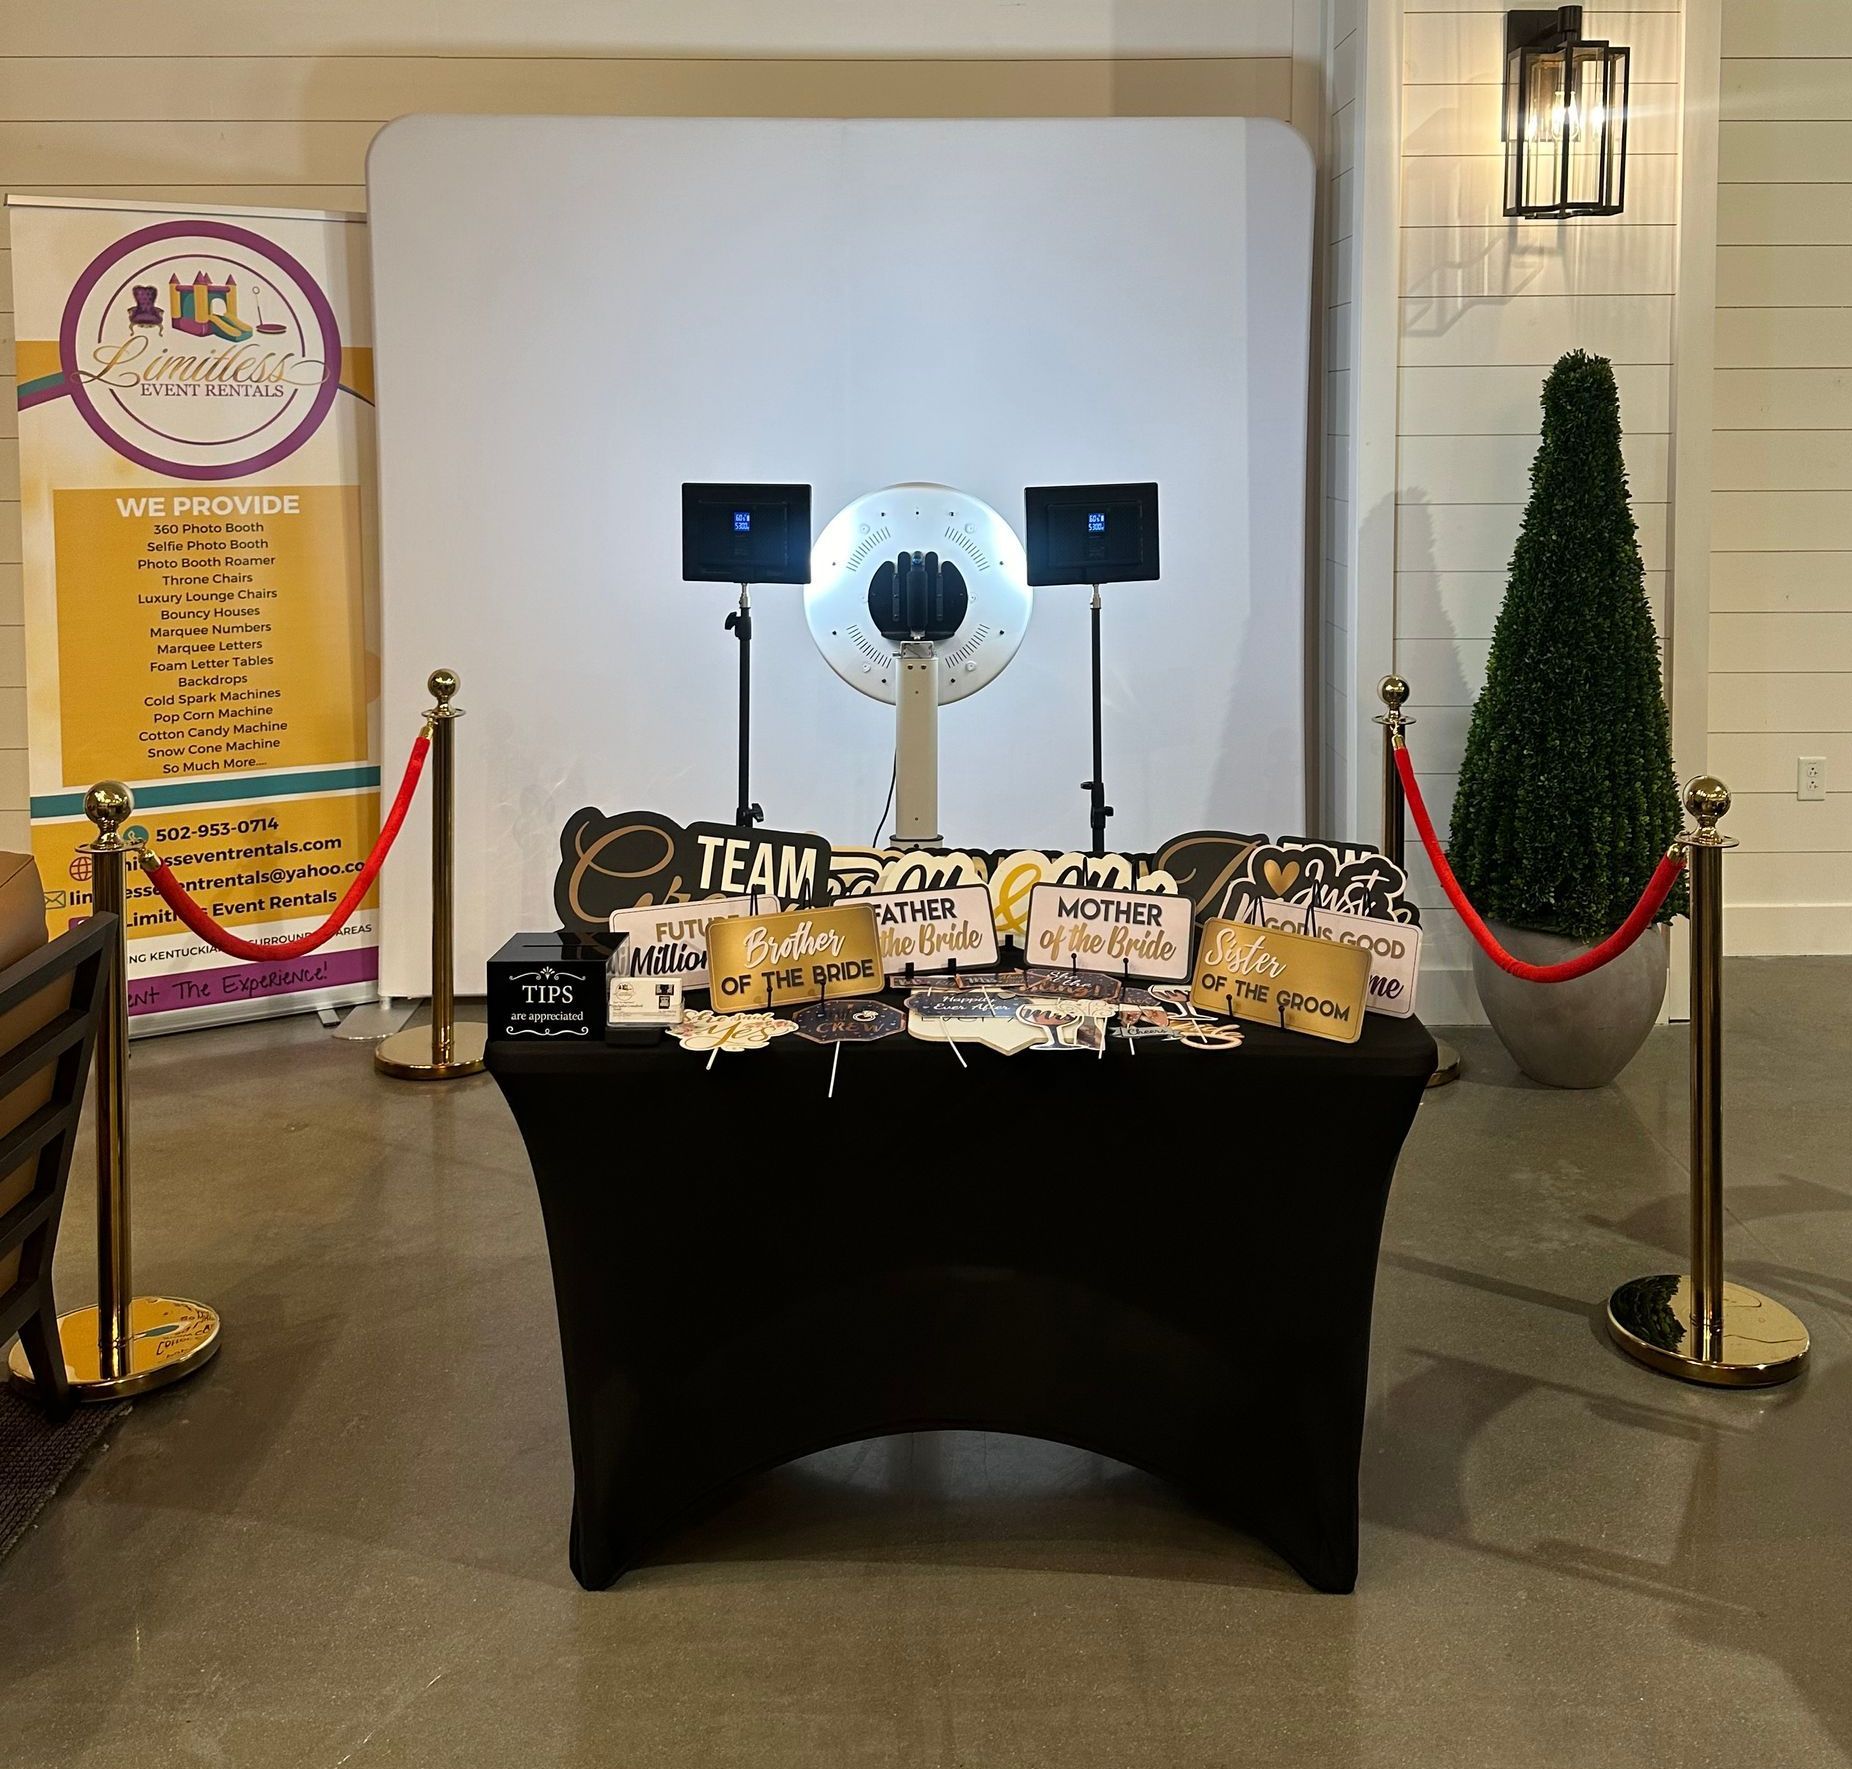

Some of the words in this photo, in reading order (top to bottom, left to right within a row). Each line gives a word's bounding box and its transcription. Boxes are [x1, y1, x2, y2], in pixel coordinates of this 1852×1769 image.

[70, 335, 331, 388] Limitless
[140, 383, 200, 397] EVENT
[206, 384, 284, 398] RENTALS
[116, 497, 165, 518] WE
[173, 495, 300, 516] PROVIDE
[153, 524, 179, 535] 360
[182, 523, 222, 535] Photo
[225, 522, 264, 533] Booth
[147, 541, 183, 552] Selfie
[187, 540, 227, 551] Photo
[230, 538, 269, 550] Booth
[138, 558, 178, 570] Photo
[181, 557, 221, 568] Booth
[225, 555, 276, 567] Roamer
[162, 575, 209, 586] Throne
[212, 573, 253, 584] Chairs
[138, 593, 182, 606] Luxury
[186, 591, 235, 603] Lounge
[238, 588, 278, 600] Chairs
[161, 609, 210, 622] Bouncy
[214, 606, 260, 618] Houses
[150, 626, 208, 640] Marquee
[212, 622, 272, 635] Numbers
[157, 642, 215, 657] Marquee
[219, 639, 262, 652] Letters
[150, 660, 187, 672] Foam
[191, 657, 229, 670] Letter
[232, 655, 274, 667] Tables
[178, 674, 248, 688] Backdrops
[144, 696, 175, 707] Cold
[178, 693, 217, 706] Spark
[220, 688, 281, 702] Machines
[154, 713, 180, 724] Pop
[183, 710, 215, 721] Corn
[218, 705, 273, 718] Machine
[139, 729, 184, 742] Cotton
[188, 726, 230, 739] Candy
[233, 721, 288, 734] Machine
[147, 747, 185, 758] Snow
[188, 743, 222, 755] Cone
[226, 738, 280, 751] Machine
[163, 763, 179, 774] So
[183, 759, 220, 772] Much
[155, 816, 279, 843] 502-953-0714
[697, 834, 817, 899] TEAM
[212, 898, 265, 917] Event
[269, 889, 337, 910] Rentals
[1057, 896, 1162, 927] MOTHER
[656, 915, 739, 942] FUTU
[150, 945, 222, 961] KENTUCKIA
[336, 924, 372, 936] AREAS
[743, 920, 846, 969] Brother
[879, 926, 915, 958] the
[918, 920, 983, 956] Bride
[1039, 924, 1067, 962] of
[1068, 922, 1105, 955] the
[1107, 925, 1177, 961] Bride
[1339, 931, 1406, 959] GOOD
[1204, 927, 1287, 978] Sister
[172, 980, 210, 1000] The
[223, 961, 328, 997] Experience!
[721, 975, 751, 996] OF
[761, 968, 804, 990] THE
[812, 959, 875, 985] BRIDE
[522, 985, 573, 1004] TIPS
[1201, 972, 1227, 992] OF
[1235, 979, 1270, 1003] THE
[1276, 990, 1351, 1022] GROOM
[511, 1013, 527, 1021] are
[528, 1011, 584, 1023] appreciated
